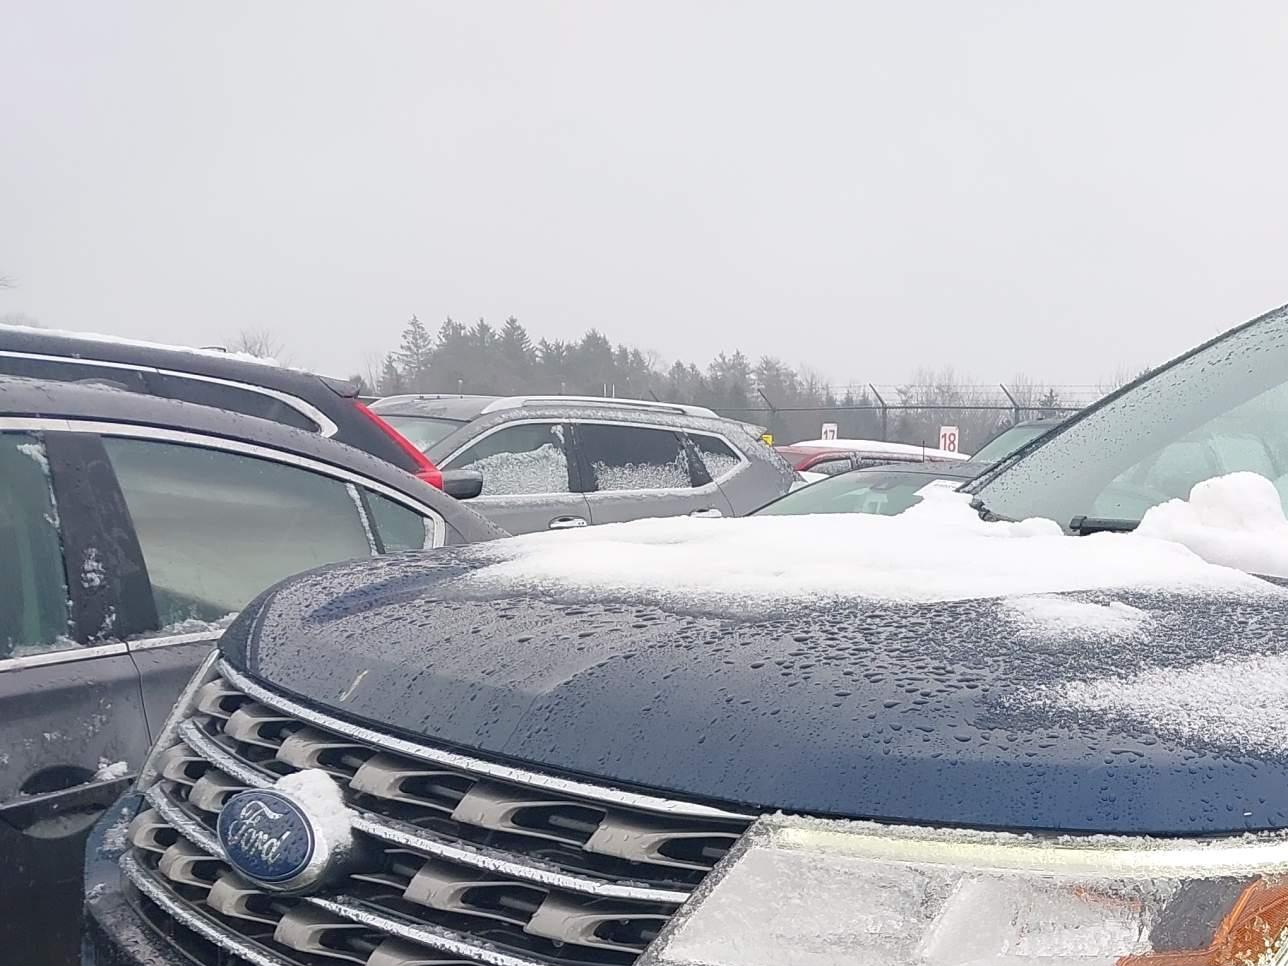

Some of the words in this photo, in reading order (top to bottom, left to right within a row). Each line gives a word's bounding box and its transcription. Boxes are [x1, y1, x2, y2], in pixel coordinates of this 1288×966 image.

[823, 429, 836, 441] 17
[941, 432, 957, 452] 18
[227, 800, 291, 864] Ford
